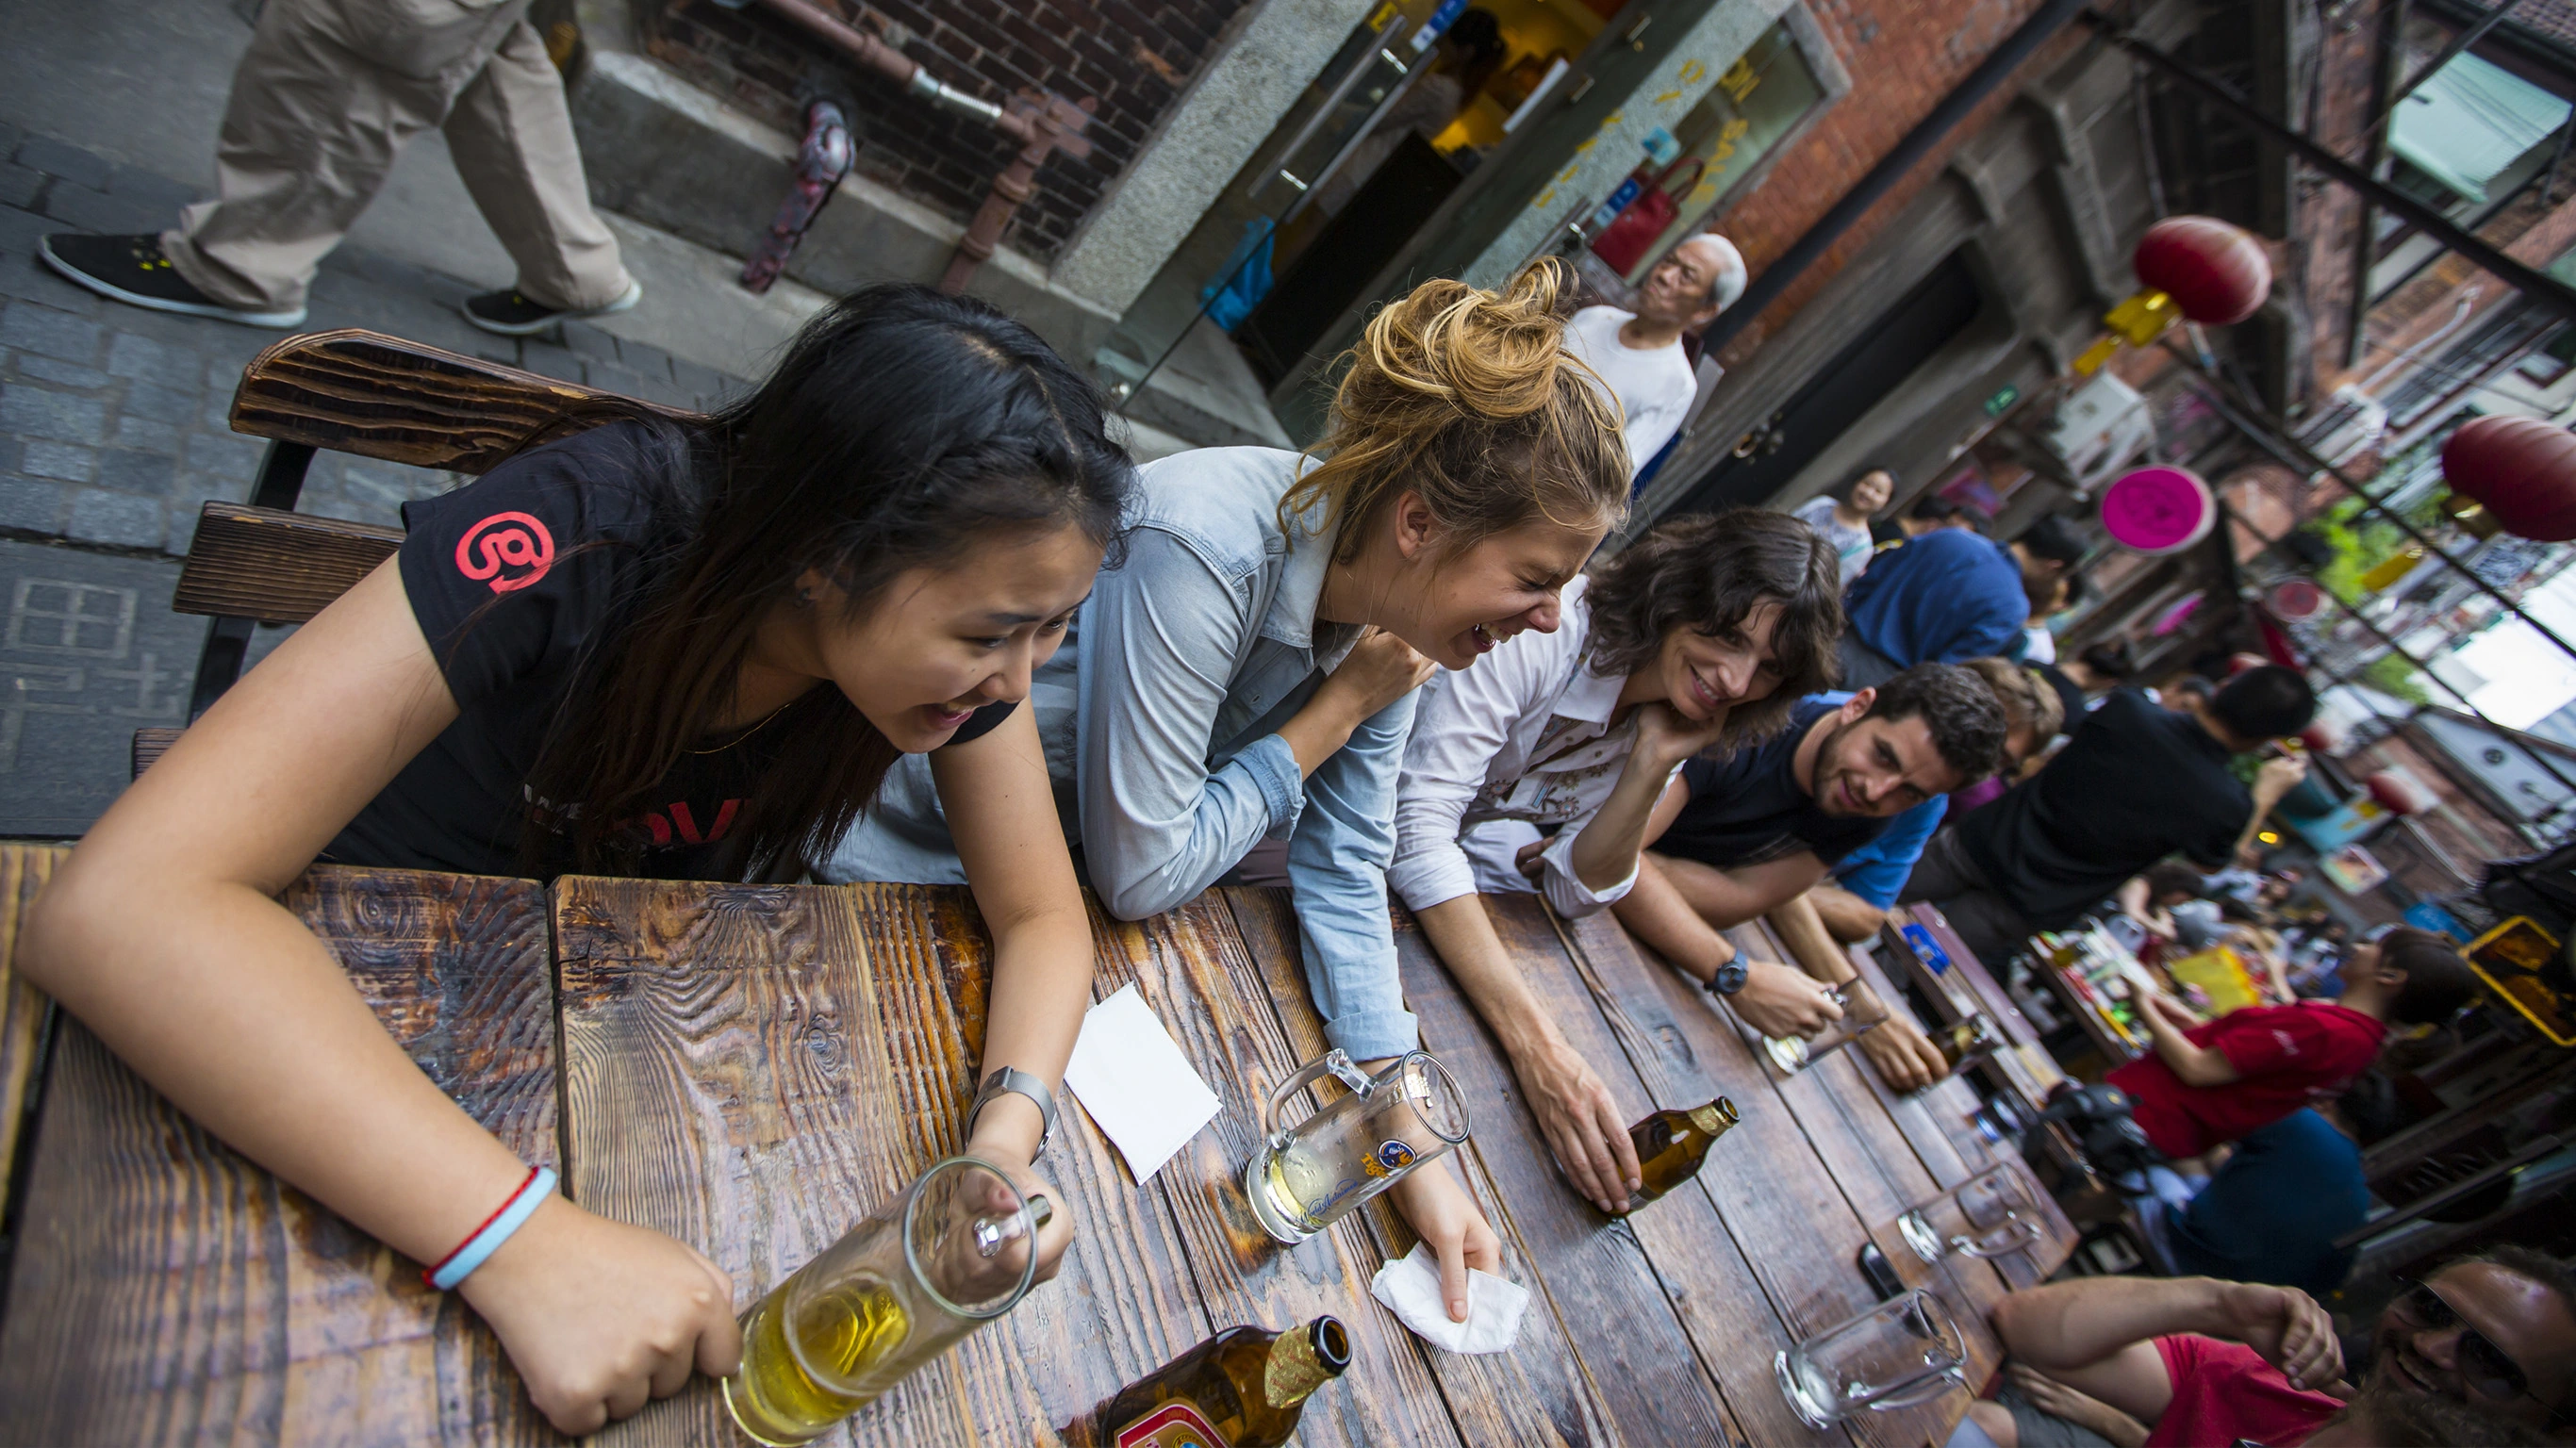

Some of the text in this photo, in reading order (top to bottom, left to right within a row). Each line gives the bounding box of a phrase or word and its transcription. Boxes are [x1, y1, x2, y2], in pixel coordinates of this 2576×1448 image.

[1361, 1152, 1391, 1179] Tiger
[1296, 1178, 1359, 1224] World Acclaimed
